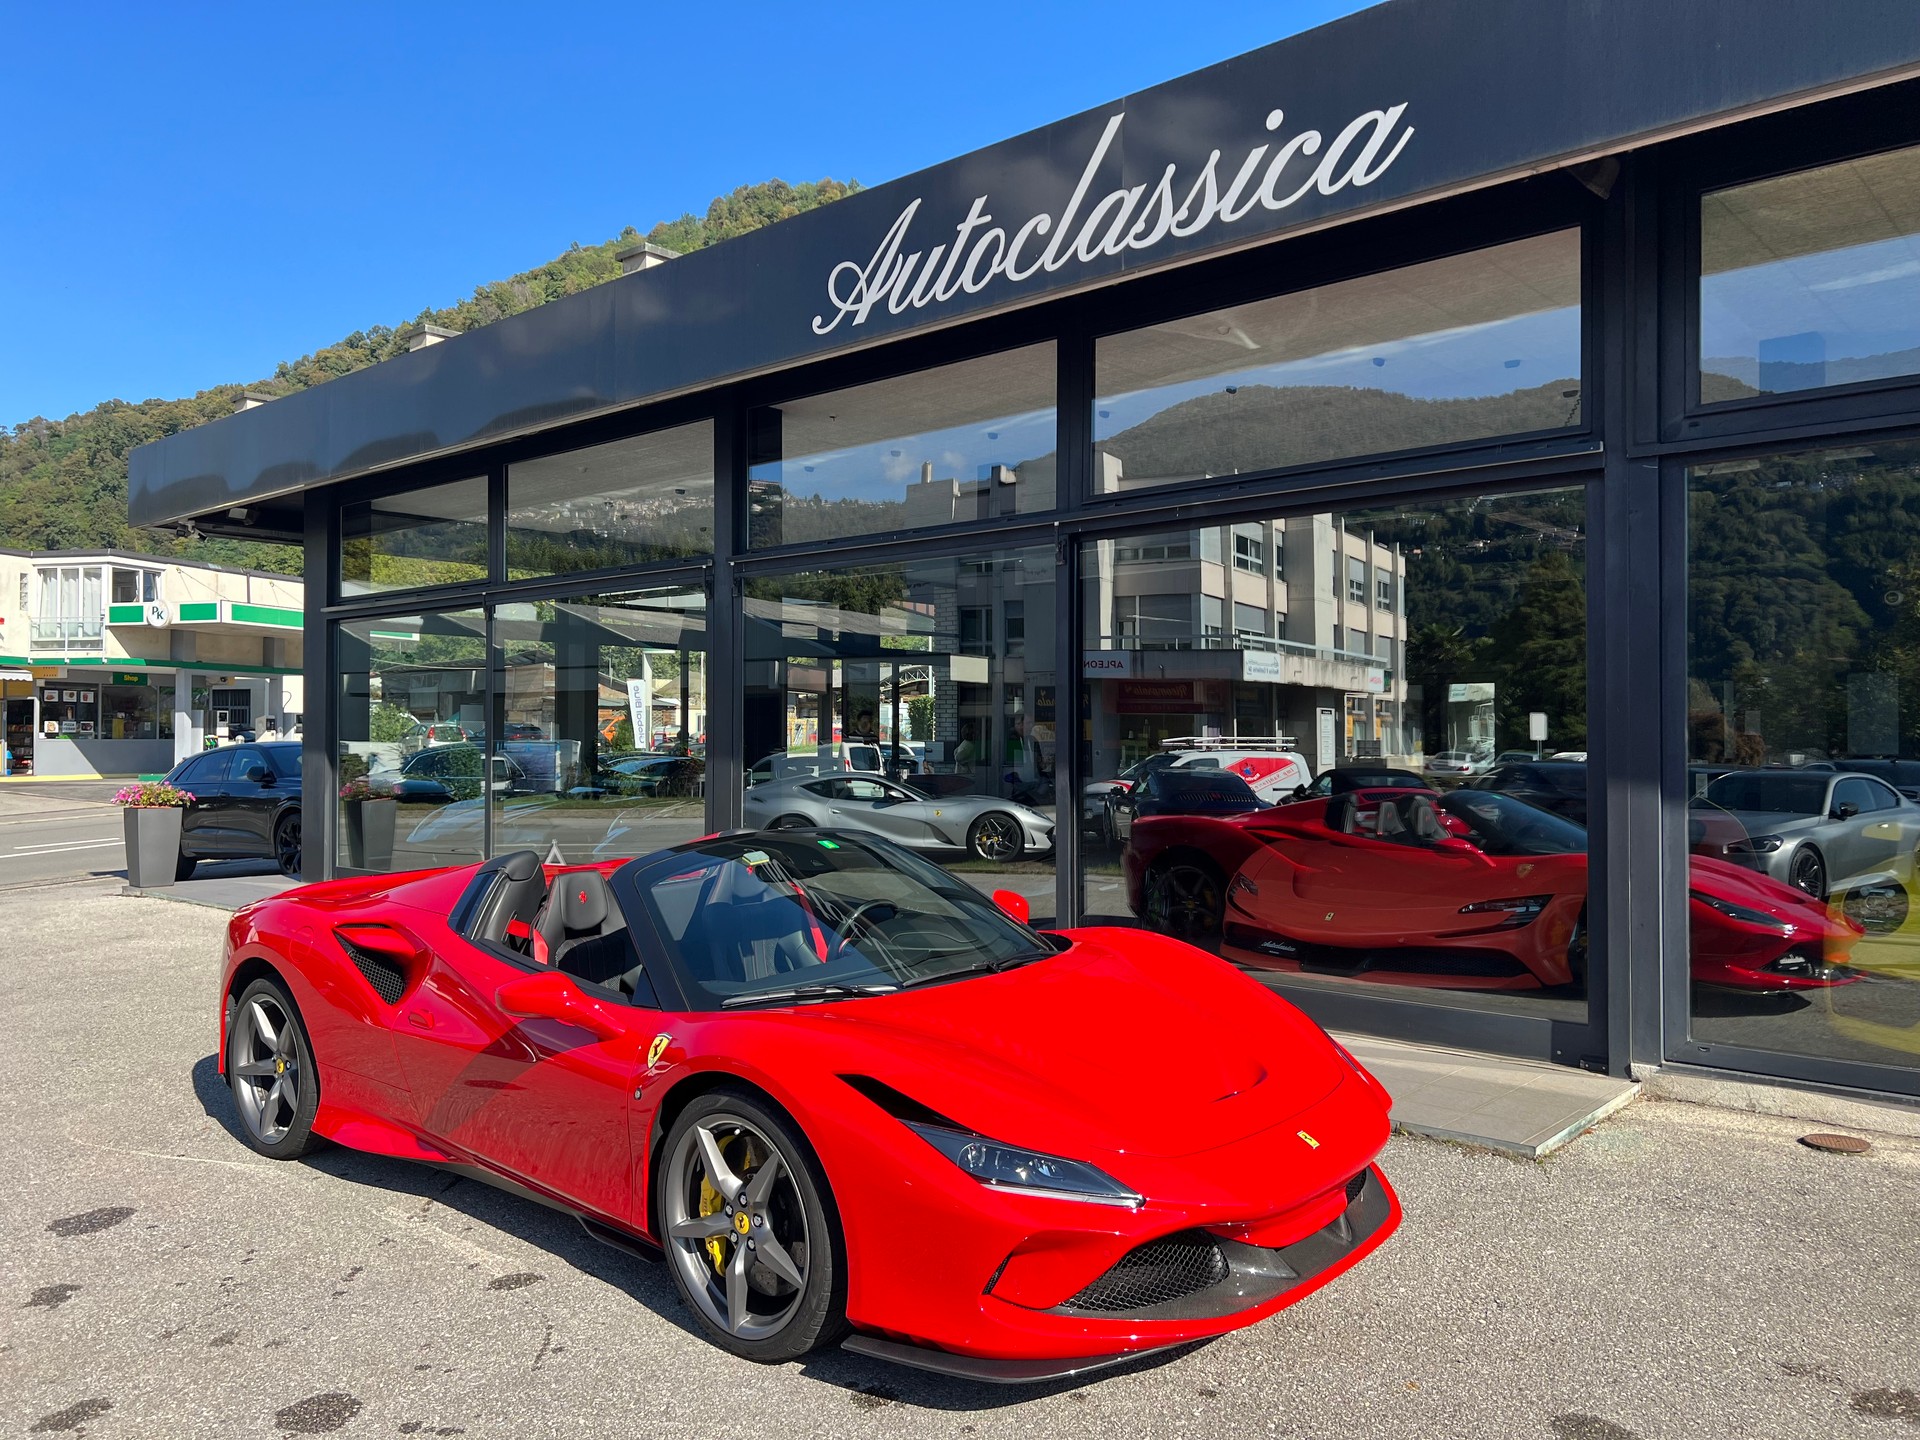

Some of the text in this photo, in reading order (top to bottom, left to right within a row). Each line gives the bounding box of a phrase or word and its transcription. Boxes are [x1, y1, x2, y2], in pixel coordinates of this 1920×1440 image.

[812, 102, 1415, 335] Autoclassica
[152, 606, 163, 619] PK
[124, 674, 138, 682] Shop
